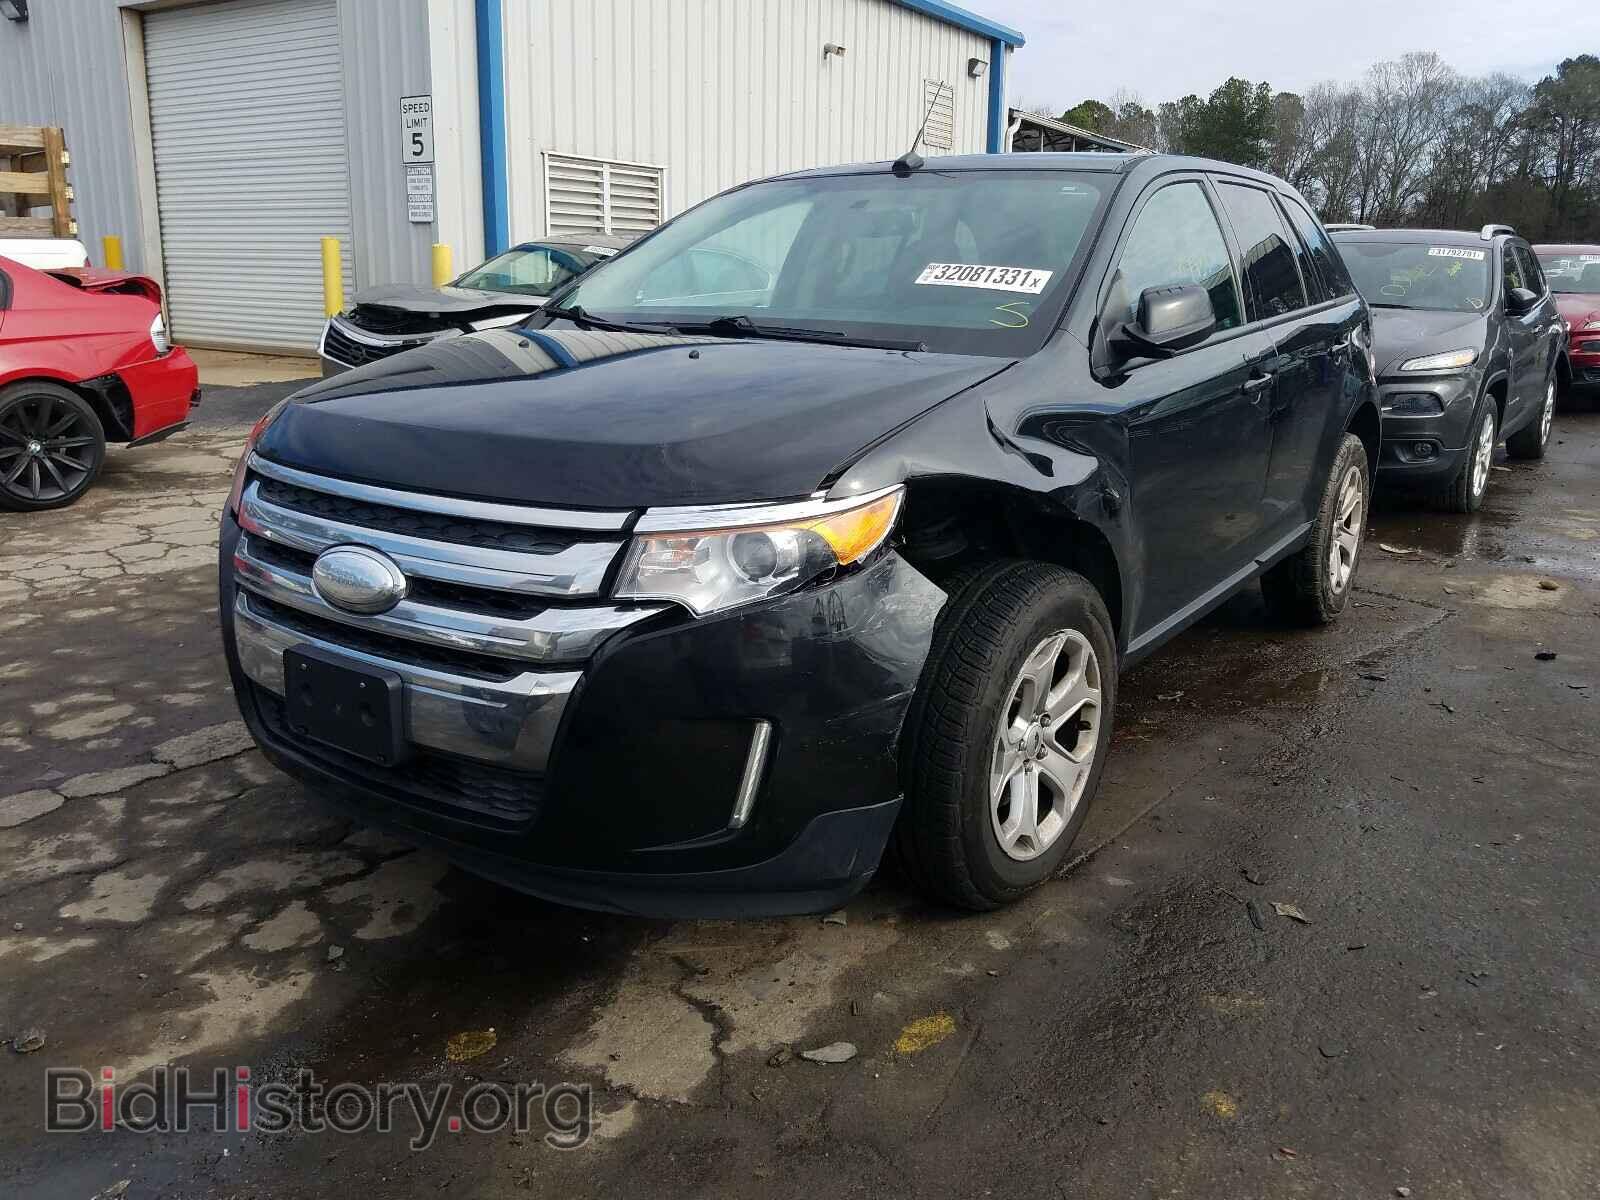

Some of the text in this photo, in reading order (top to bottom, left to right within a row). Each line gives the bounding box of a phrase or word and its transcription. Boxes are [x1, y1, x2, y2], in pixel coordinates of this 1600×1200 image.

[402, 103, 430, 114] SPEED
[406, 118, 428, 129] LIMIT
[412, 132, 424, 156] 5
